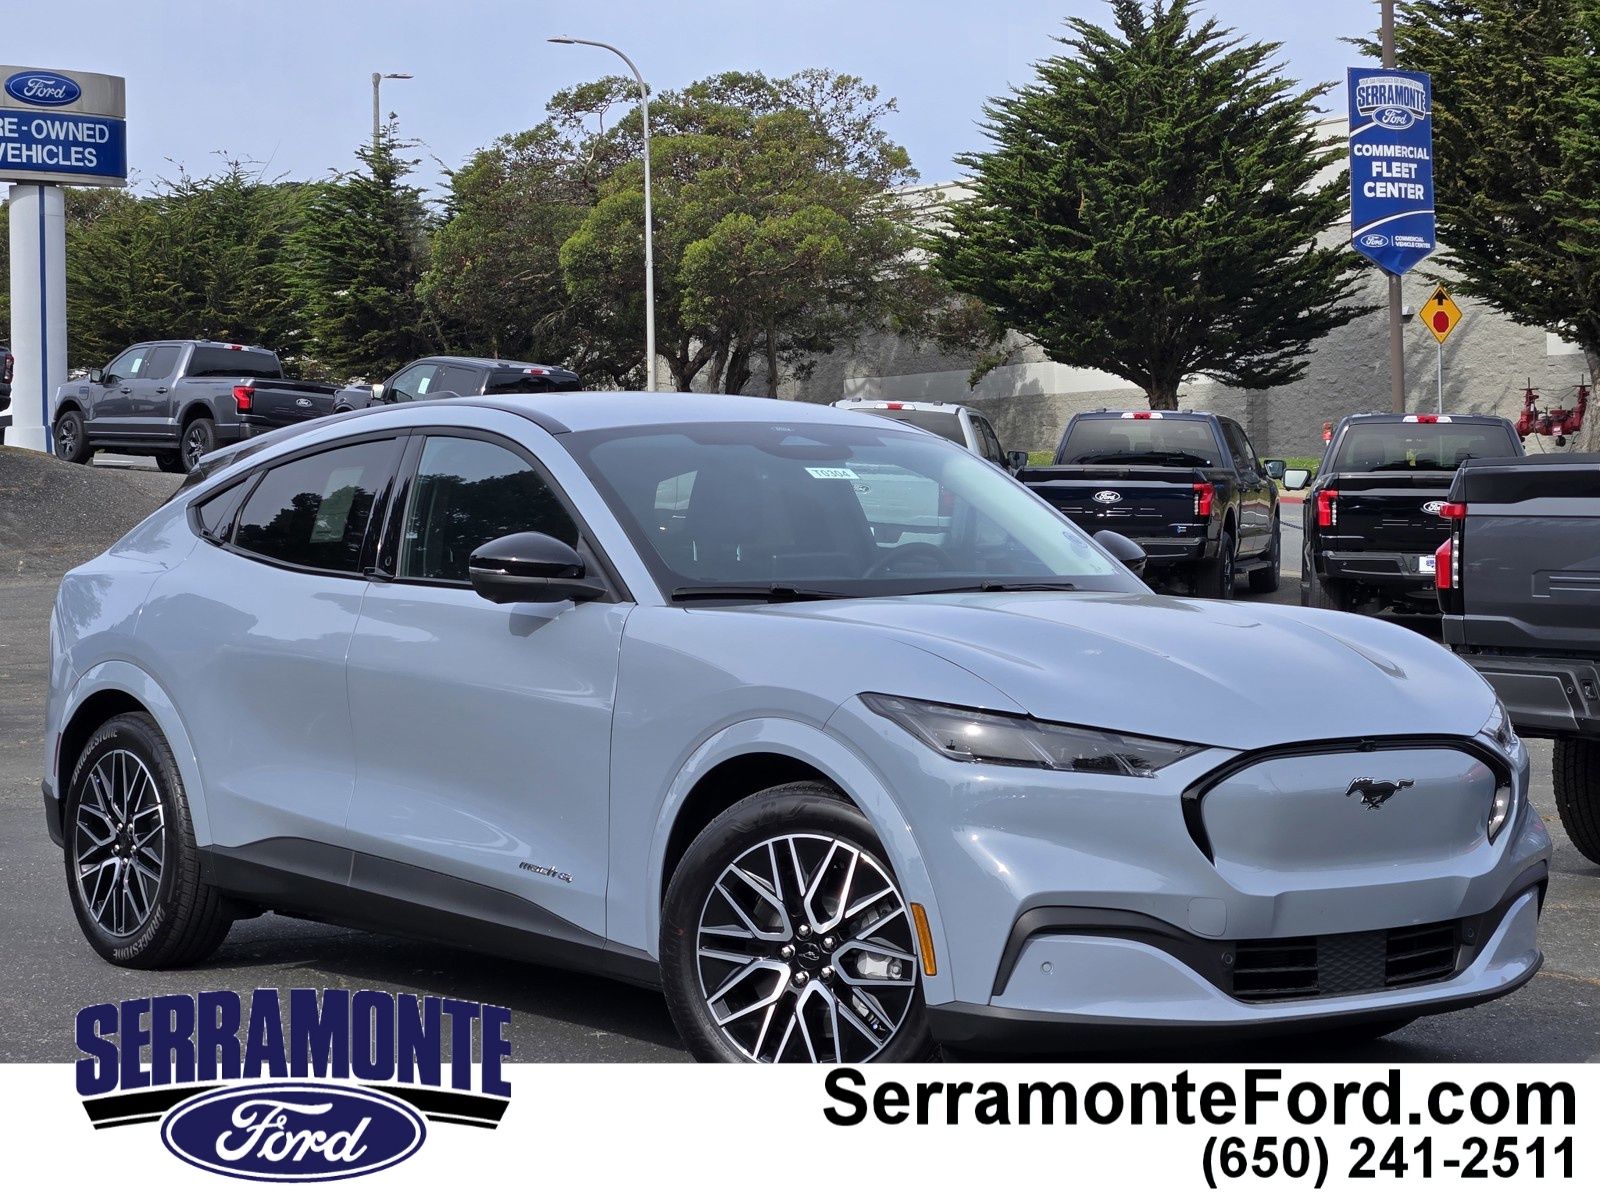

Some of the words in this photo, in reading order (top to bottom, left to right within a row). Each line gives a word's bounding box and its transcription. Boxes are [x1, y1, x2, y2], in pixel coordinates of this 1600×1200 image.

[23, 78, 67, 99] Ford
[1357, 84, 1425, 112] SERRAMONTE
[1382, 108, 1407, 124] Ford
[0, 117, 110, 144] E-OWNED
[1353, 144, 1430, 160] COMMERCIAL
[1371, 161, 1418, 179] FLEET
[1363, 181, 1424, 200] CENTER
